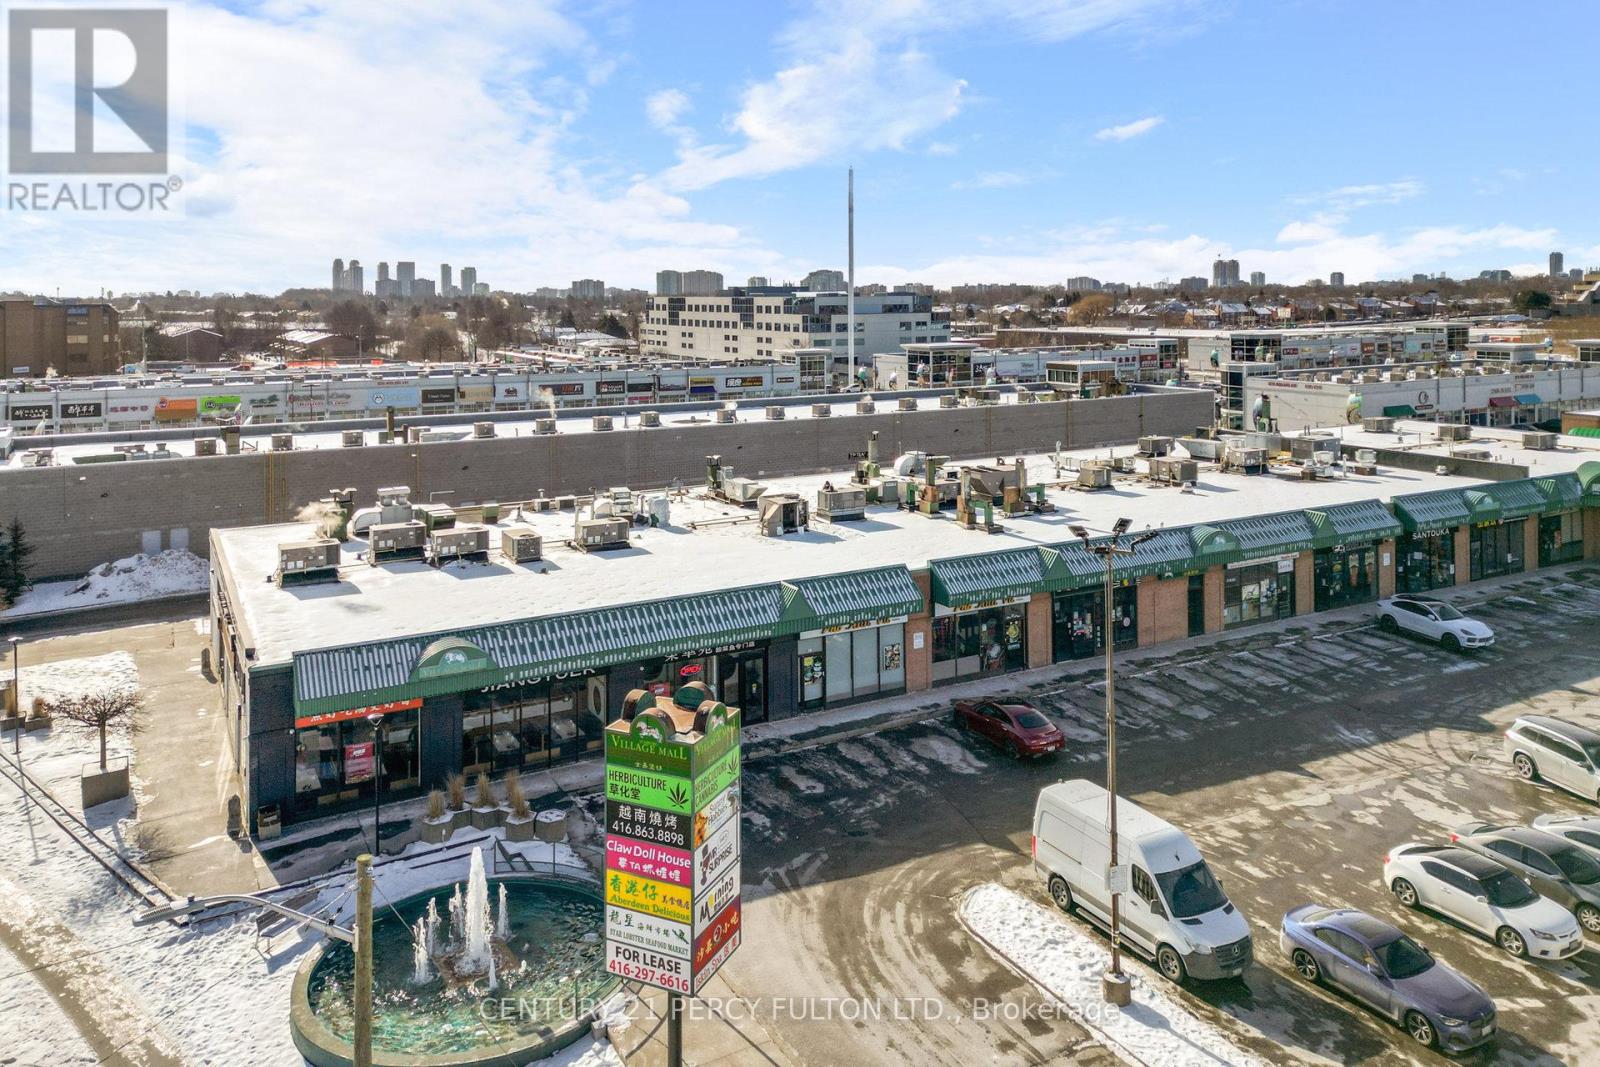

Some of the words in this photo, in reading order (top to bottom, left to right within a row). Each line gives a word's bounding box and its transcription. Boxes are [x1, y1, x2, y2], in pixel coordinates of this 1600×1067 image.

[1412, 528, 1450, 540] SANTOUKA
[611, 734, 656, 754] VILLAGE
[658, 747, 687, 760] MALL
[608, 770, 667, 791] HERBICULTURE
[618, 805, 678, 830] 越南燒烤
[612, 820, 684, 846] 416.863.8898
[606, 840, 632, 855] Claw
[633, 845, 656, 860] Doll
[657, 850, 691, 869] House
[610, 874, 659, 901] 香港仔
[610, 894, 650, 911] Aberdeen
[653, 904, 690, 921] Delicious
[623, 932, 645, 944] LOBSTER
[667, 942, 689, 956] MARKET
[615, 946, 641, 965] FOR
[642, 952, 682, 975] LEASE
[609, 959, 690, 992] 416-297-6616
